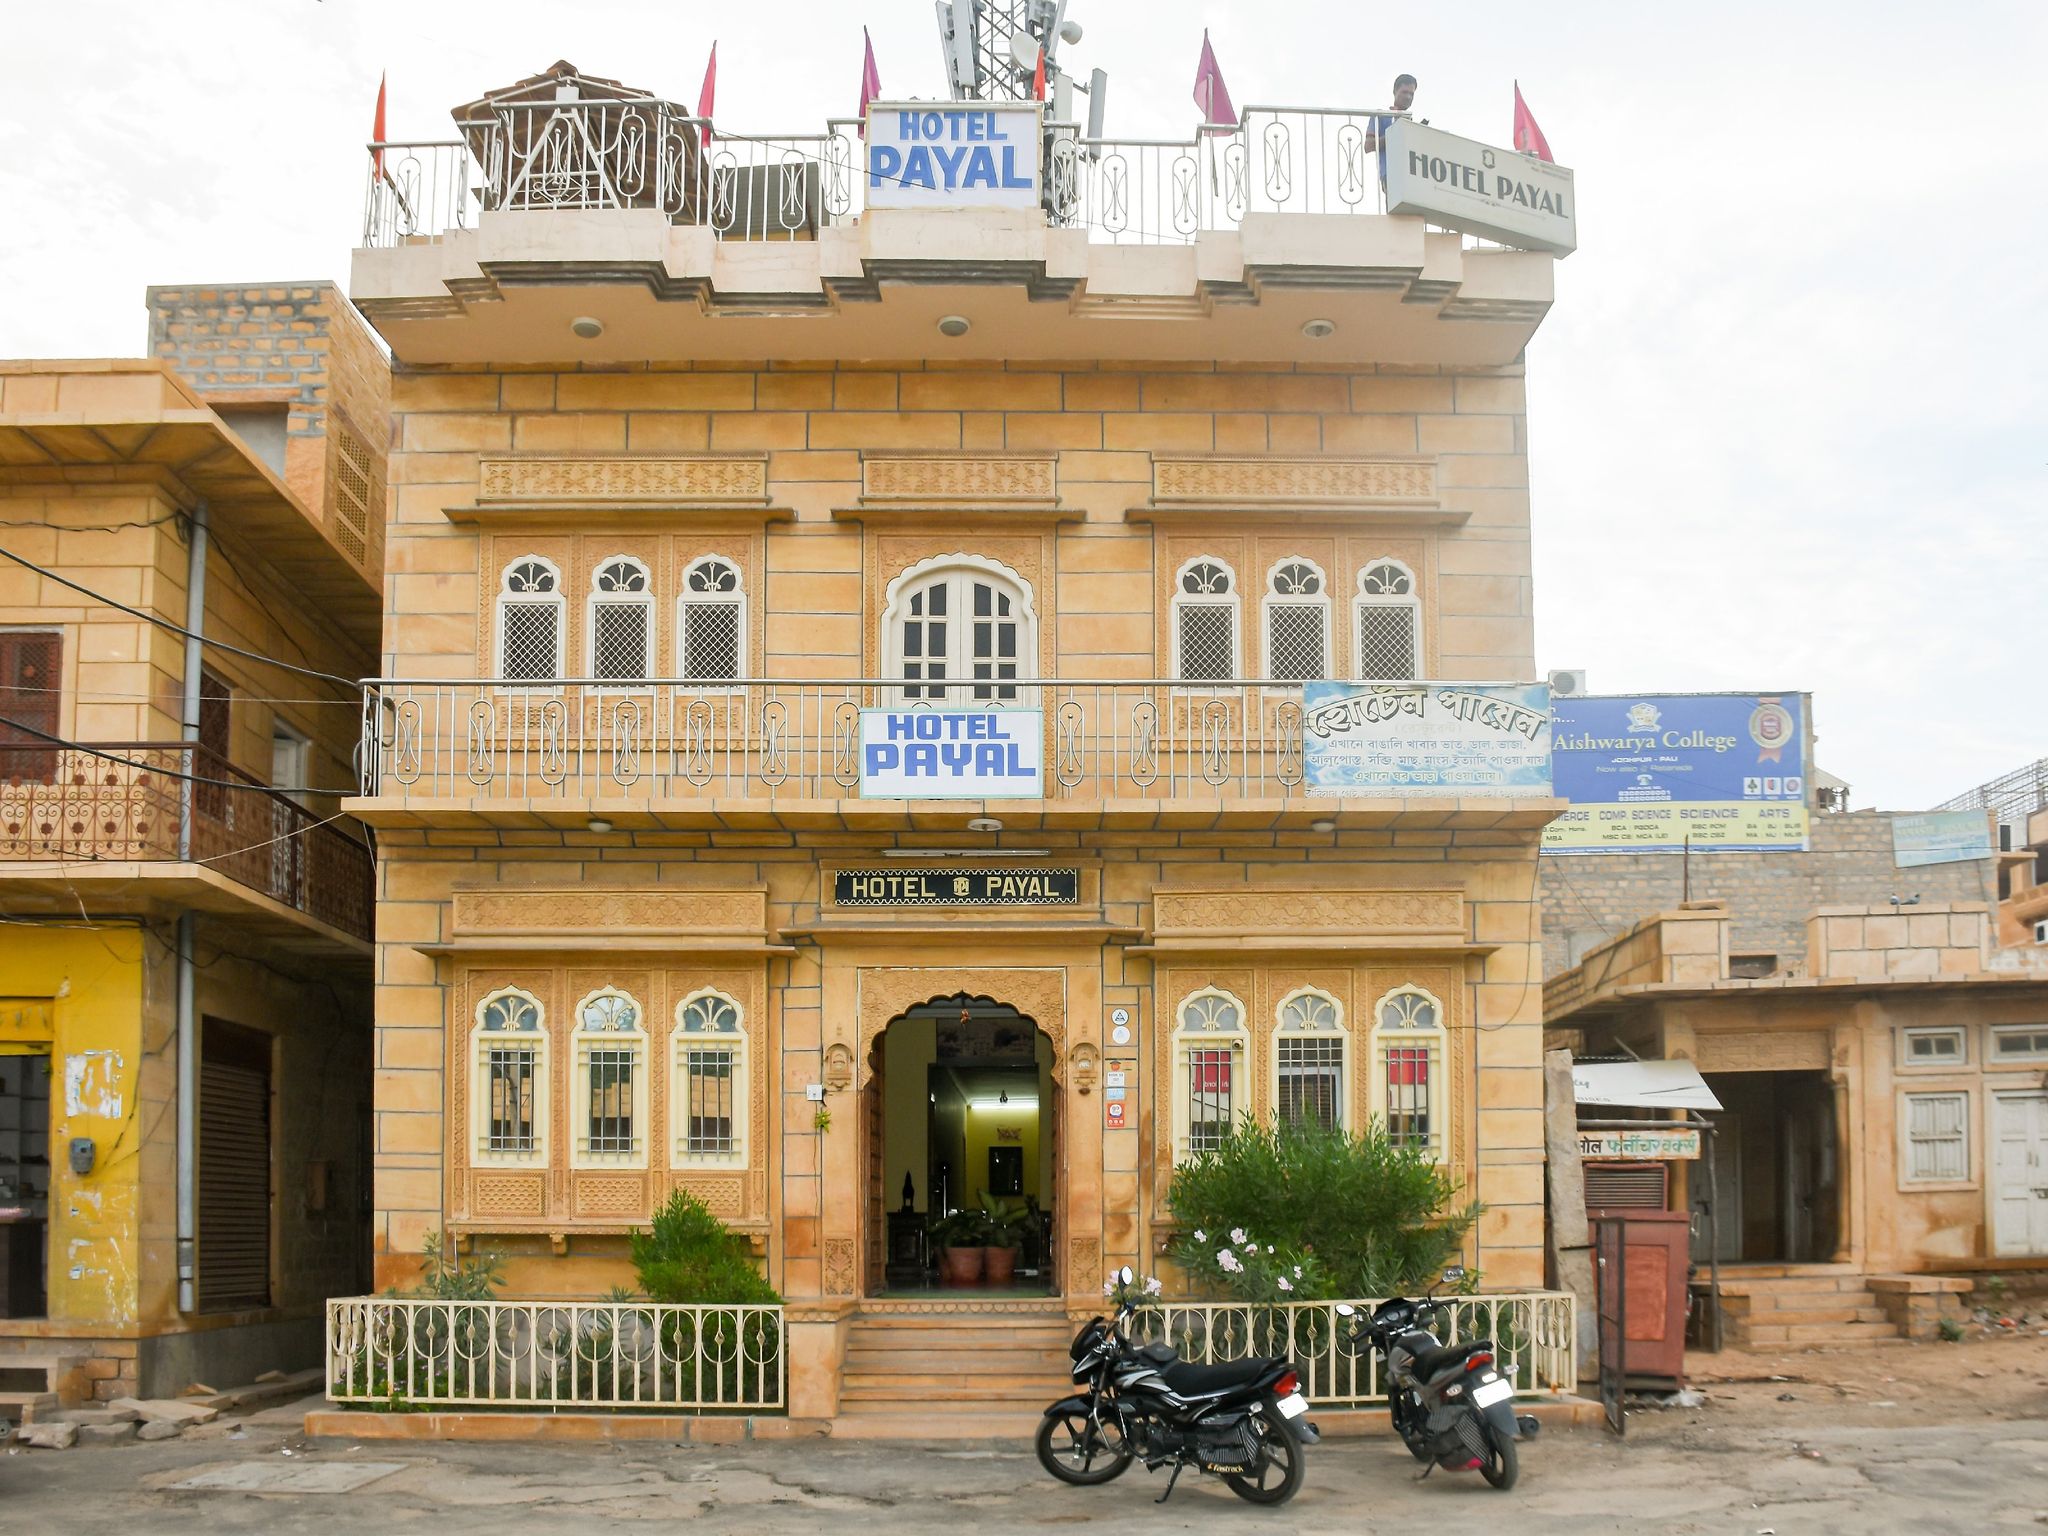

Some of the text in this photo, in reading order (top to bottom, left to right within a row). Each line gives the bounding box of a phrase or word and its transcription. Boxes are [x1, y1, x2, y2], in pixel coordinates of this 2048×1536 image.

[900, 112, 1008, 141] HOTEL
[870, 145, 1033, 190] PAYAL
[1409, 150, 1491, 196] HOTEL
[1496, 175, 1569, 219] PAYAL
[1306, 684, 1547, 741] হোটেল পায়েল
[888, 714, 1010, 740] HOTEL
[1328, 739, 1363, 750] এখানে
[1552, 730, 1737, 754] Aishwarya College
[866, 743, 1036, 777] PAYAL
[1632, 810, 1672, 820] SCIENCE
[1680, 808, 1739, 819] SCIENCE
[1758, 808, 1790, 818] ARTS
[852, 876, 936, 898] HOTEL
[986, 876, 1060, 898] PAYAL
